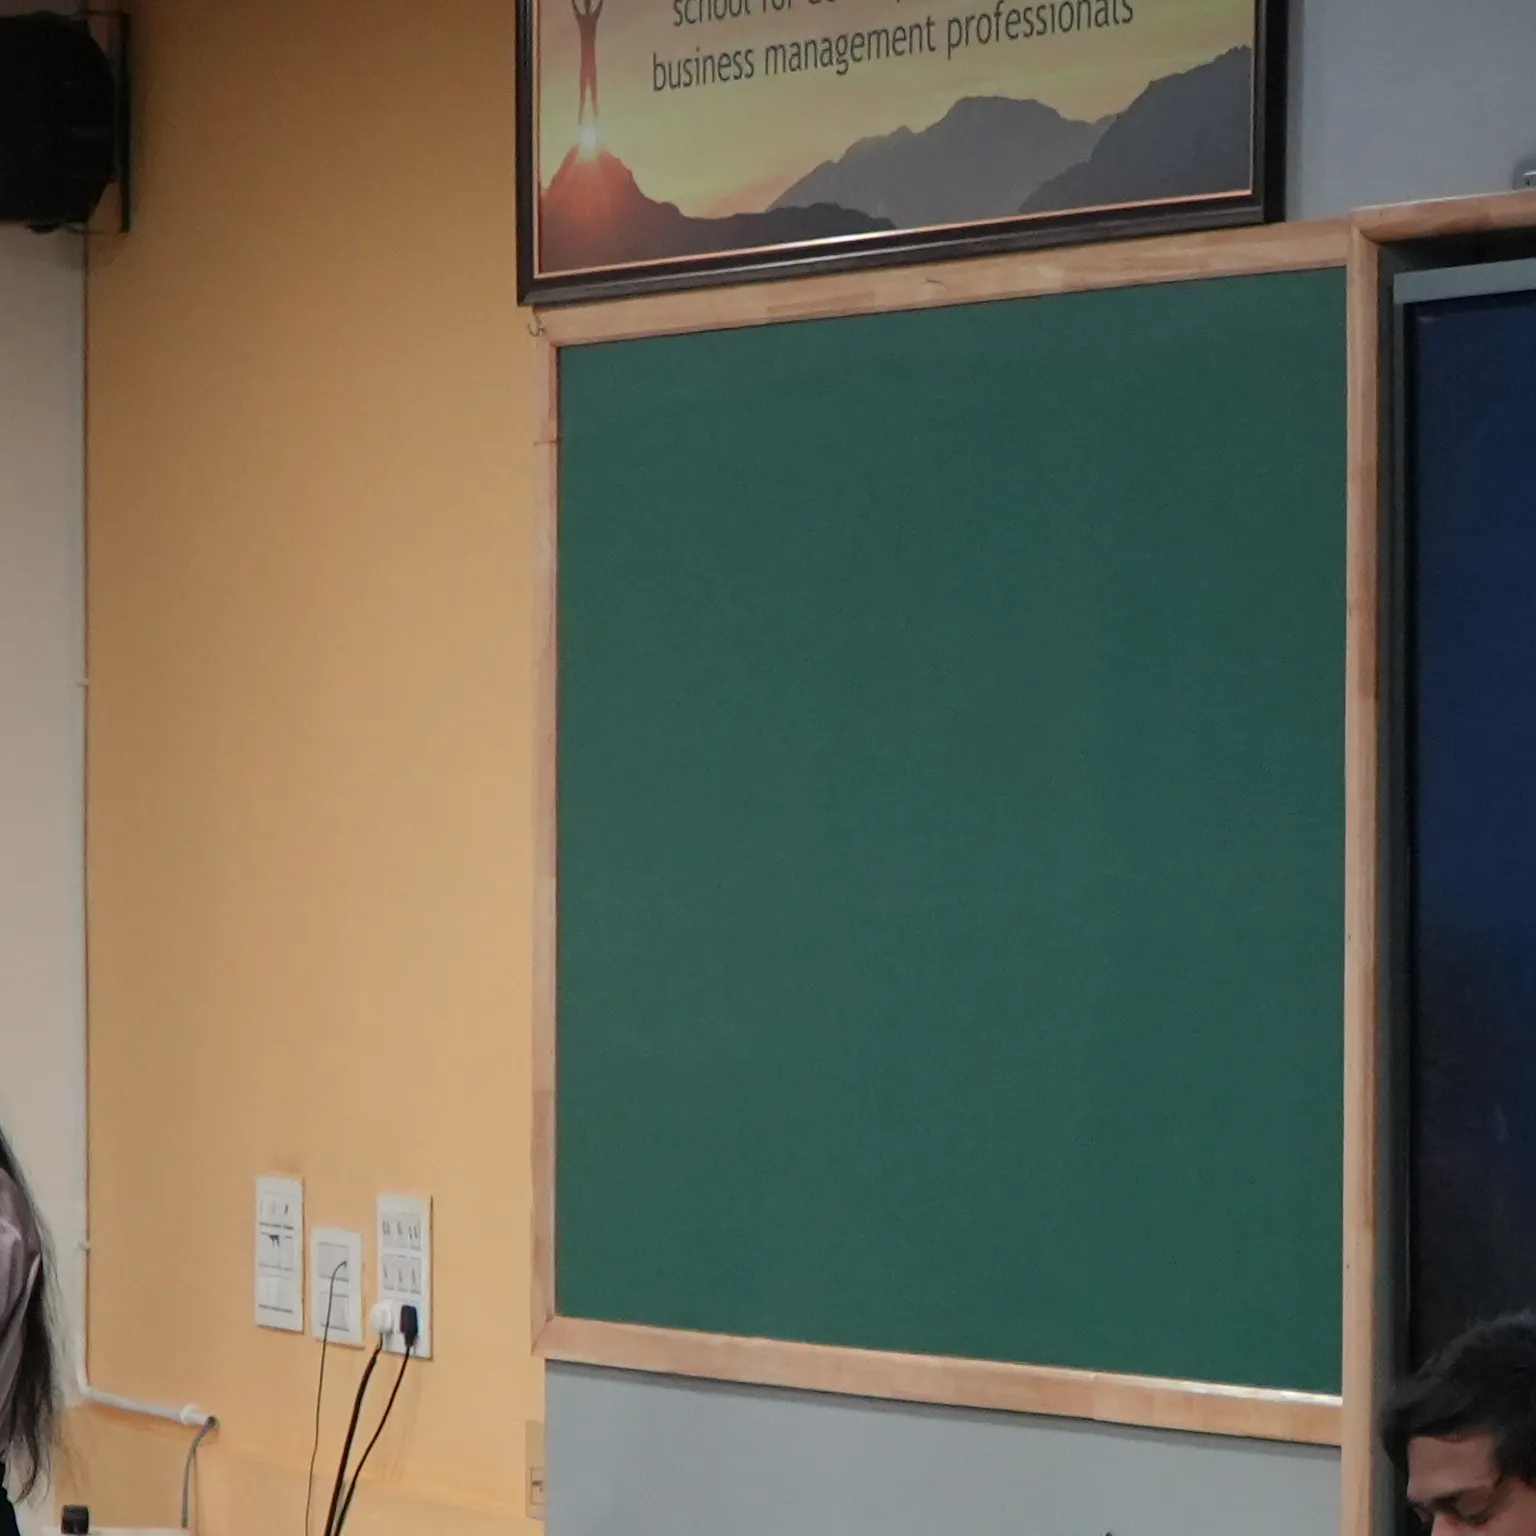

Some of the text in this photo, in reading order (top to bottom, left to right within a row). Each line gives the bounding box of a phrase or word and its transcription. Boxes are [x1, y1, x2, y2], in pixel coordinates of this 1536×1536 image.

[653, 0, 1133, 92] business management professionals
